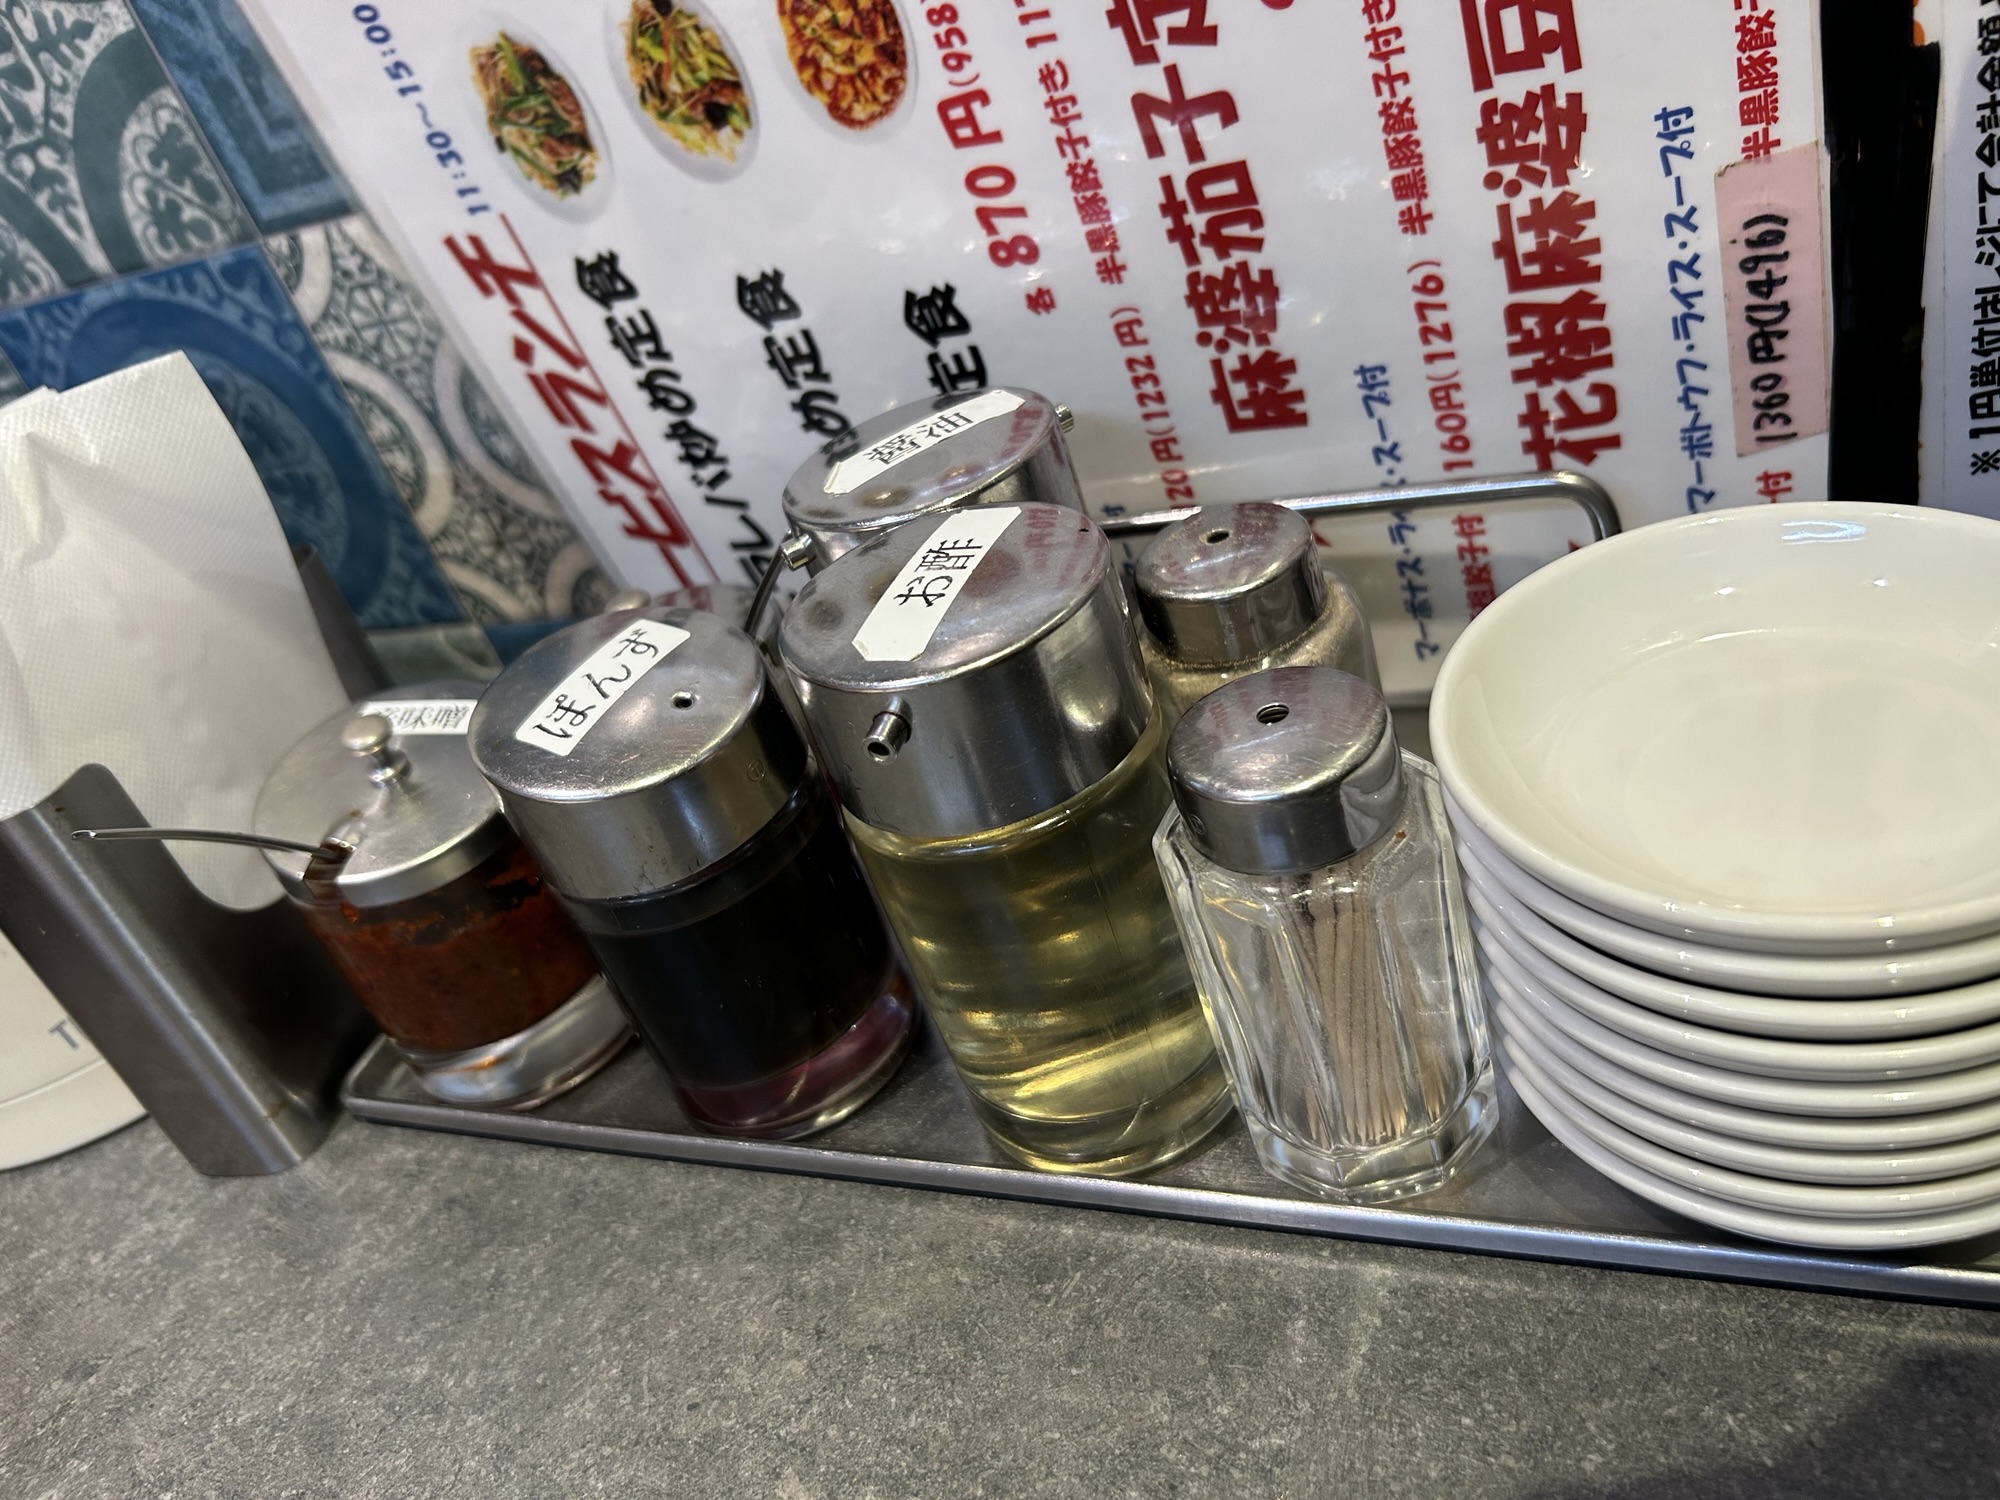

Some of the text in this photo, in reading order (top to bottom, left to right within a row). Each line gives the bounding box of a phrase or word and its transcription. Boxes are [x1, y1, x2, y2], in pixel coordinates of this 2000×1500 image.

[1024, 286, 1057, 316] 各
[532, 628, 659, 739] ぽんず
